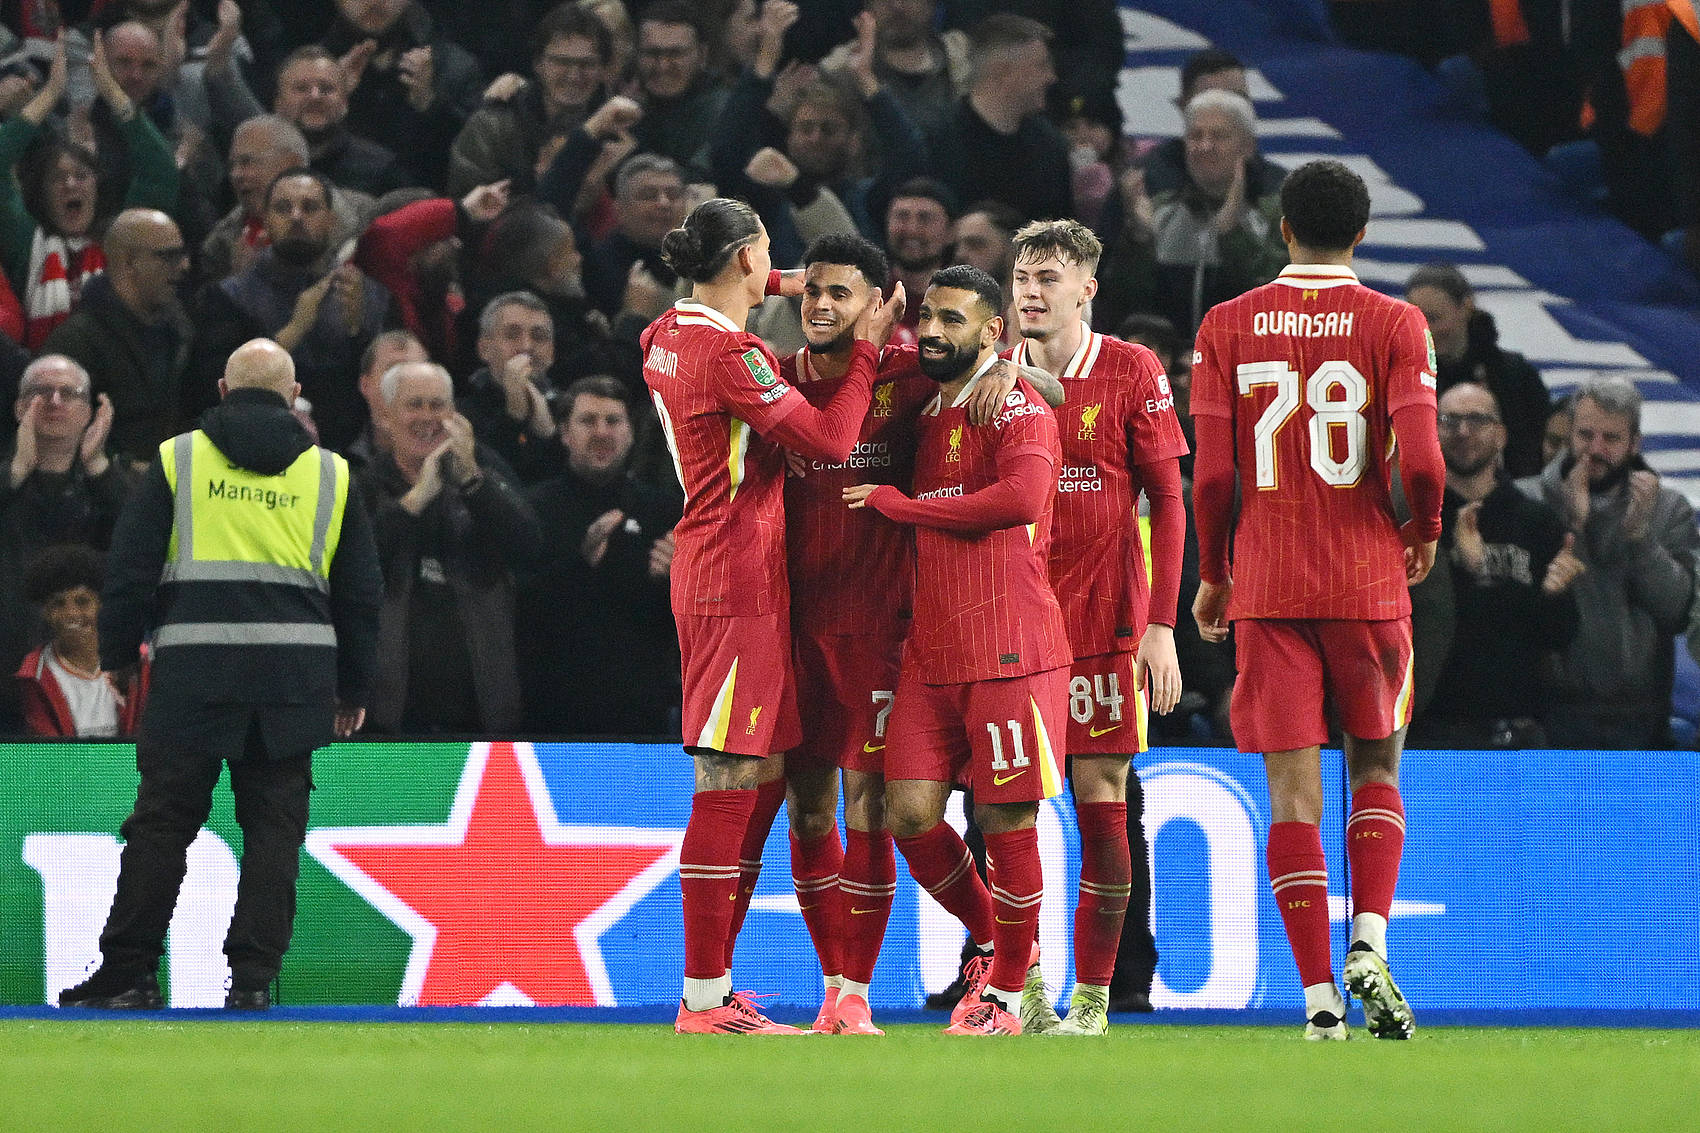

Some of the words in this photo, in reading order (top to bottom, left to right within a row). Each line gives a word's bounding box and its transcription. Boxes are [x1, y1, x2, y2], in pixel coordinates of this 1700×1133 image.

[1253, 310, 1354, 337] QUANSAH
[873, 409, 893, 418] LFC
[1236, 360, 1371, 491] 78
[1077, 431, 1097, 441] LFC
[945, 452, 961, 463] LFC
[208, 479, 300, 510] Manager
[1069, 672, 1125, 723] 84
[871, 690, 896, 737] 7
[986, 719, 1032, 771] 11
[1355, 831, 1384, 840] LFC
[1288, 900, 1311, 910] LFC
